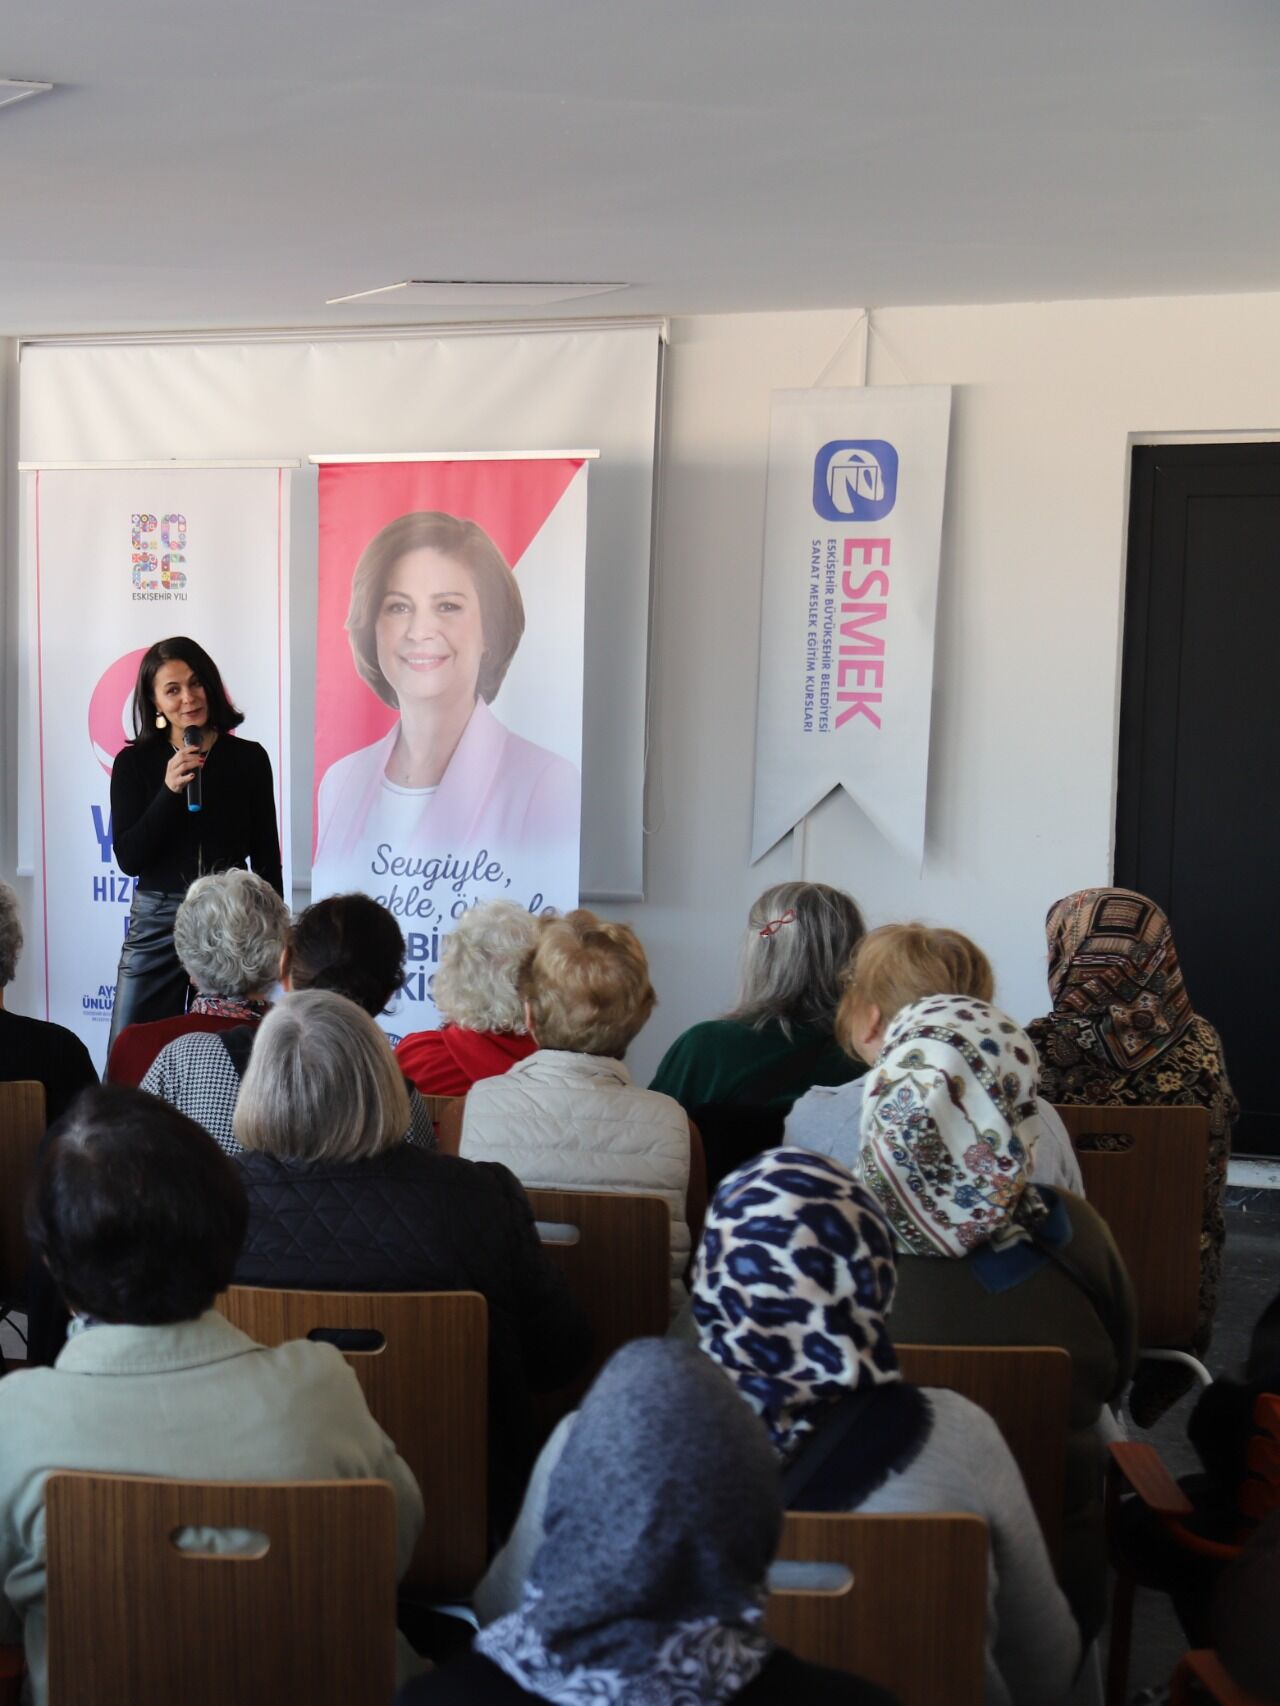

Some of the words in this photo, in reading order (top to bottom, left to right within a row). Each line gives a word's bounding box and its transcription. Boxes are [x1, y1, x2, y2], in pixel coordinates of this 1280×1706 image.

[810, 539, 821, 580] SANAT
[824, 539, 838, 595] ESKİŞEHİR
[807, 584, 819, 628] MESLEK
[806, 632, 819, 672] EĞİTİM
[834, 538, 891, 730] ESMEK
[803, 675, 816, 732] KURSLARI
[818, 673, 831, 733] BELEDİYESİ
[371, 843, 512, 892] Sevgiyle,
[82, 994, 114, 1010] ÜNLÜ
